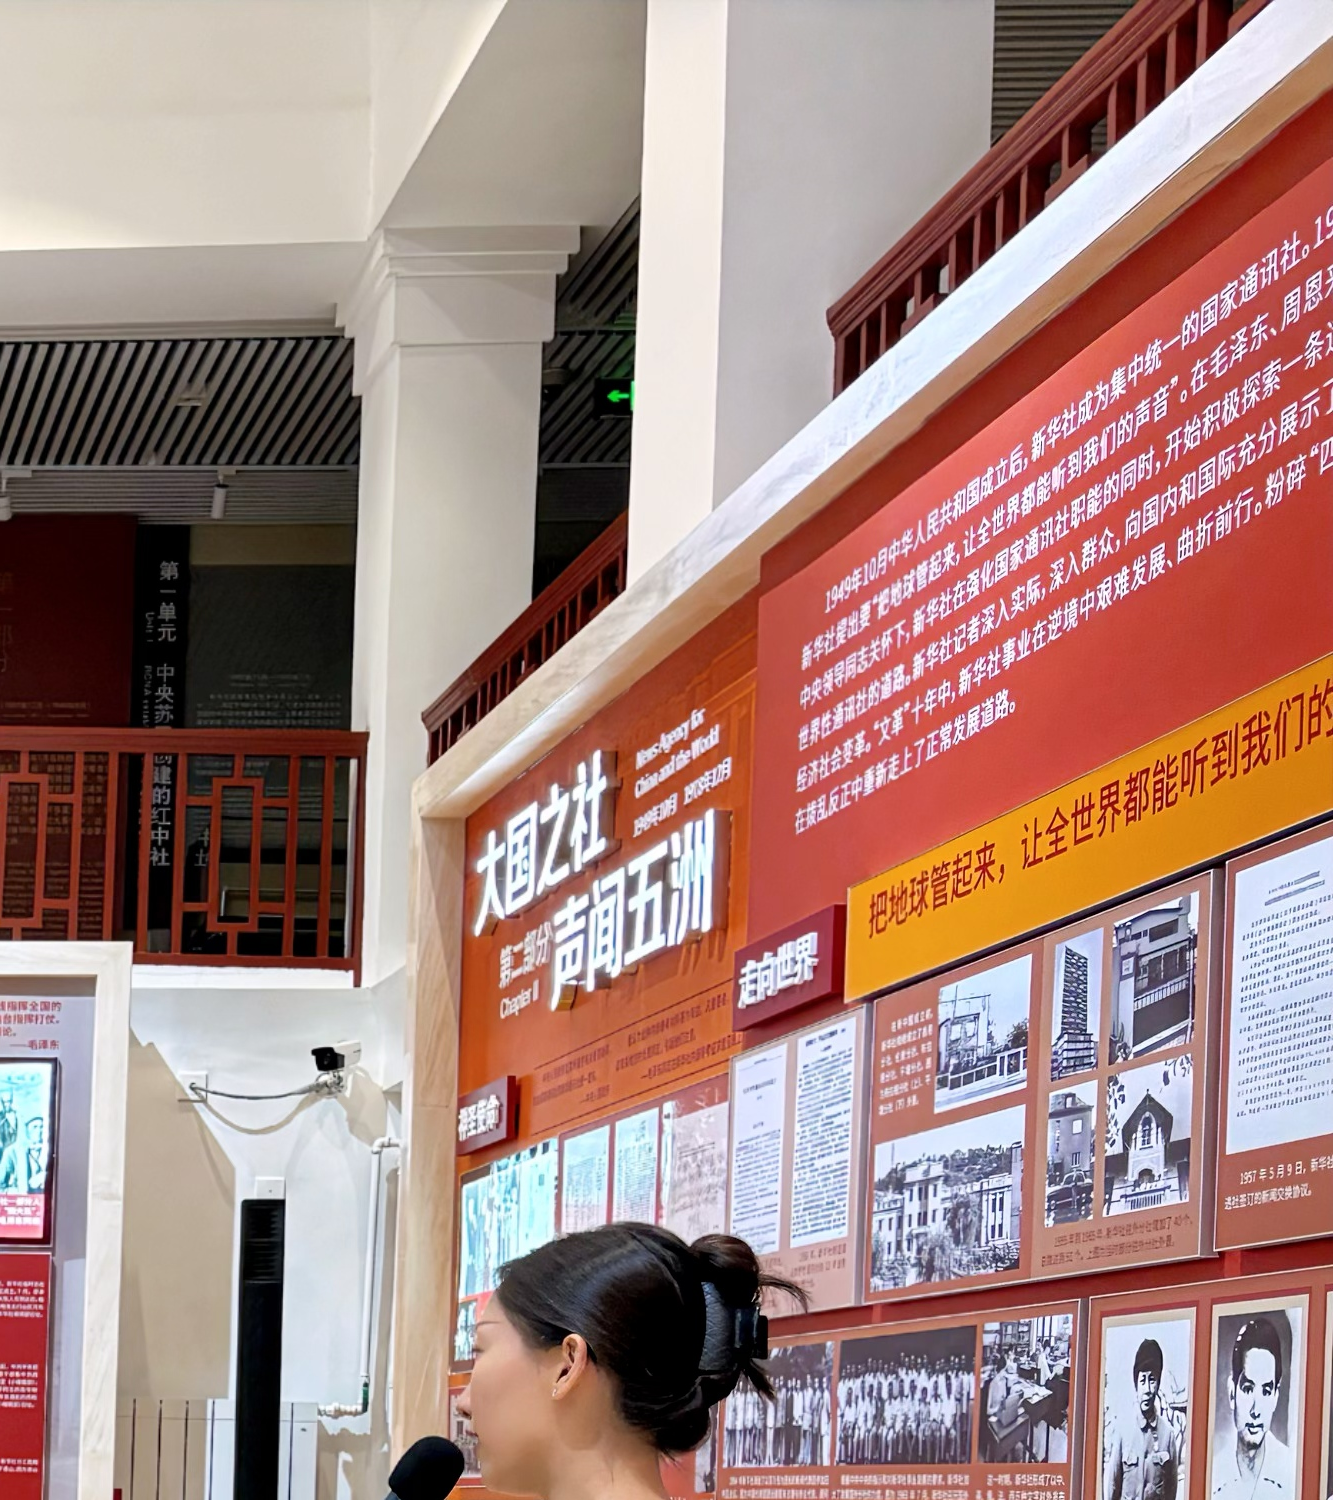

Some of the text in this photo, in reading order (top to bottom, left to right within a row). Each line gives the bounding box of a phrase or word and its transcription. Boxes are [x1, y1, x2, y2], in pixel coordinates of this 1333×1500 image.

[157, 561, 179, 642] 第一单元
[659, 720, 689, 753] Agency
[691, 708, 706, 730] for
[794, 688, 1016, 835] 在拨乱反正中重新走上了正常发展道路。
[474, 750, 608, 937] 大国之社
[550, 808, 716, 1012] 声闻五洲
[499, 921, 555, 989] 第二部分
[737, 931, 819, 1009] 走向世界
[499, 987, 531, 1019] Chapter
